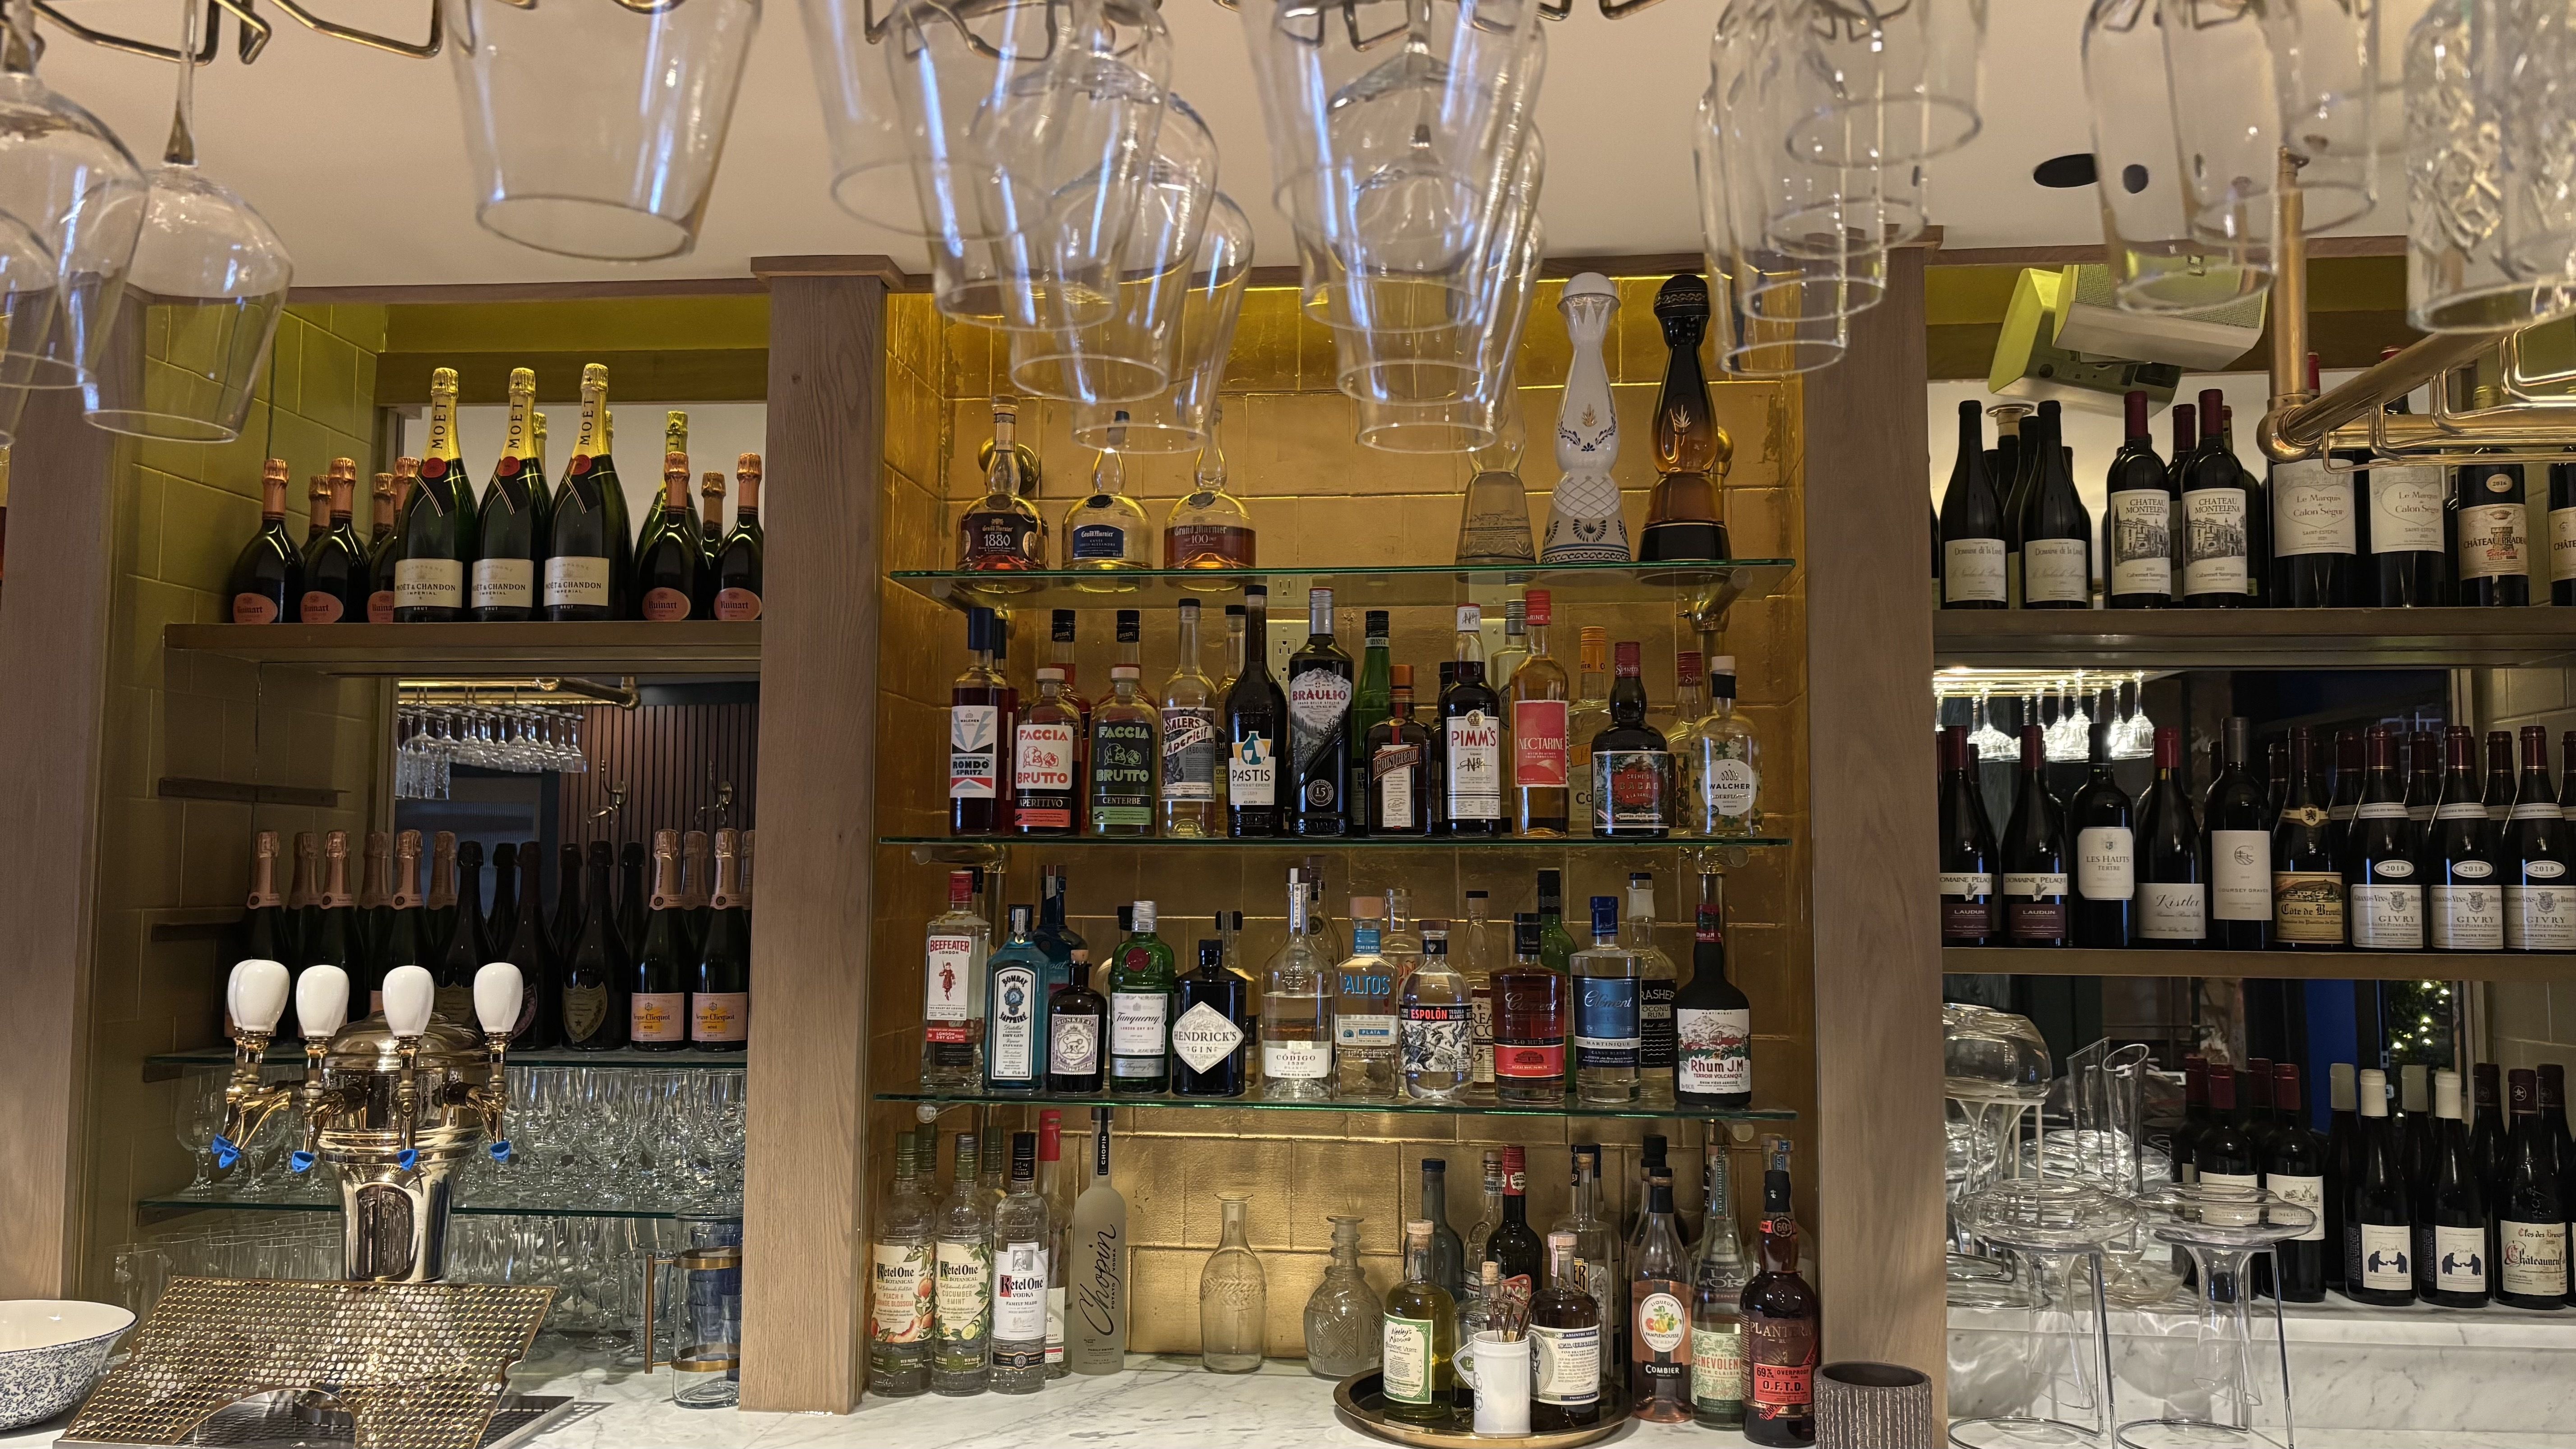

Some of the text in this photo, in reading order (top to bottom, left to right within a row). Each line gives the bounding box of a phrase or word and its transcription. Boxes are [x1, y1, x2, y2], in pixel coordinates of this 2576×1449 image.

[2310, 494, 2341, 503] Marquis
[2194, 506, 2240, 514] MONTELENA
[2320, 508, 2344, 518] Ségur
[1174, 524, 1227, 536] Grand Marnier
[984, 534, 1011, 547] 1880
[1192, 534, 1209, 544] 100
[2463, 537, 2496, 549] CHÂTEAU
[417, 583, 455, 591] CHANDON
[563, 581, 601, 589] CHANDON
[649, 601, 677, 609] Ruinart
[721, 601, 749, 609] Ruinart
[1165, 716, 1200, 732] SALERS
[1020, 729, 1068, 741] FACCIA
[1099, 727, 1149, 739] FACCIA
[1451, 727, 1496, 747] PIMM'S
[1166, 727, 1208, 755] Aperitif
[1518, 738, 1564, 750] NECTARINE
[1375, 750, 1417, 775] COINTREAU
[1017, 772, 1068, 784] BRUTTO
[1096, 769, 1149, 782] BRUTTO
[1232, 769, 1270, 782] PASTIS
[1316, 787, 1326, 797] 15
[1620, 782, 1659, 790] CACAO
[1019, 799, 1063, 807] APERITIVO
[2156, 894, 2200, 909] Kistler
[2281, 904, 2313, 915] Côte de
[929, 940, 970, 953] BEEFEATER
[1002, 975, 1028, 987] BOMBAY
[1343, 974, 1391, 995] ALTOS
[645, 1013, 670, 1022] Clicquot
[709, 1013, 735, 1022] Clicquot
[999, 1012, 1028, 1023] SAPPHIRE
[1055, 1017, 1085, 1026] MONKEY
[1116, 1012, 1160, 1024] Tanqueray
[1174, 1031, 1237, 1042] HENDRICK'S
[1691, 1059, 1743, 1072] Rhum J.M
[2518, 1227, 2534, 1237] Clos
[877, 1263, 915, 1282] Ketel One
[940, 1261, 978, 1281] Ketel One
[1000, 1275, 1044, 1297] Ketel One
[1079, 1224, 1121, 1336] Chopin
[1645, 1364, 1679, 1374] COMBIER
[1763, 1381, 1804, 1392] O.F.T.D.
